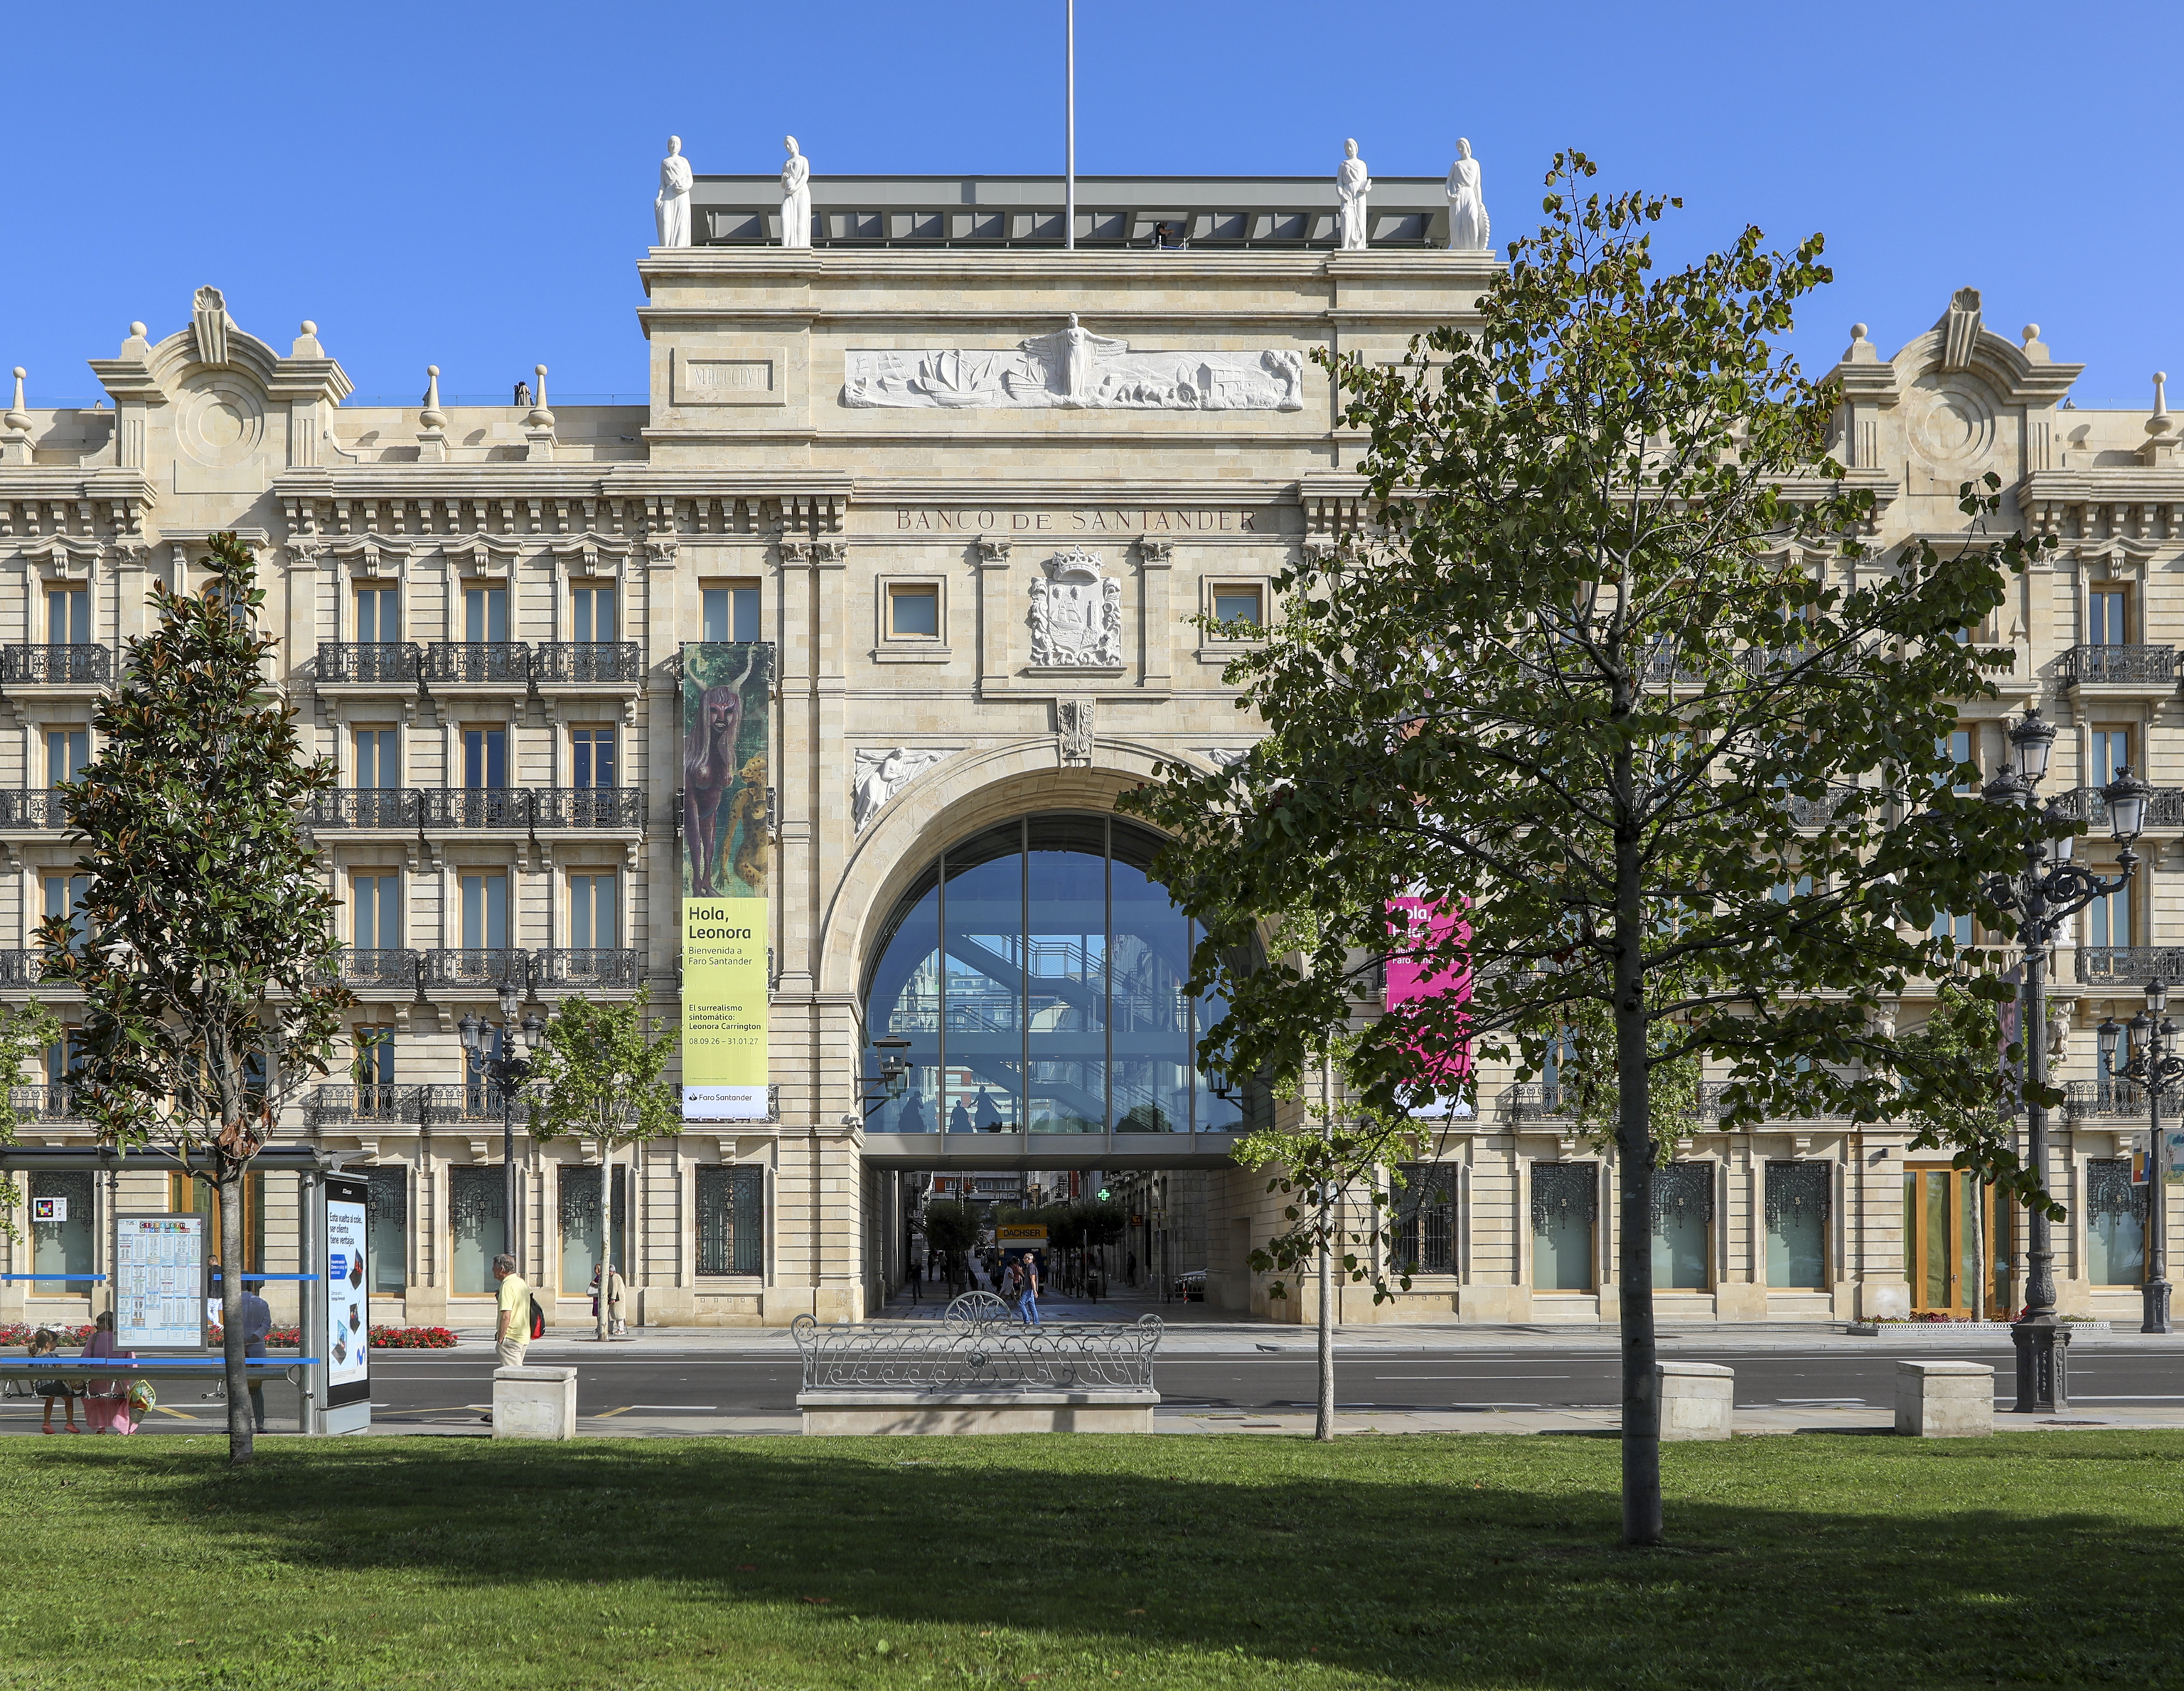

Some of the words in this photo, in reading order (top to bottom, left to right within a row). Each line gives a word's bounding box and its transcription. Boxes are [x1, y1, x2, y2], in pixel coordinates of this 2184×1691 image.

[694, 368, 766, 385] MDCCCLVII
[897, 509, 995, 530] BANCO
[1012, 513, 1052, 530] DE
[1072, 510, 1256, 530] SANTANDER
[689, 906, 729, 923] Hola,
[689, 925, 751, 939] Leonora
[688, 946, 735, 955] Bienvenida
[709, 957, 753, 966] Santander
[721, 1023, 761, 1032] Carrington
[329, 1212, 338, 1222] Esta
[338, 1213, 350, 1223] vuelta
[350, 1214, 354, 1224] al
[336, 1225, 349, 1234] cliente
[1003, 1229, 1041, 1237] DACHSER
[330, 1235, 339, 1244] tiene
[339, 1236, 355, 1247] ventajas
